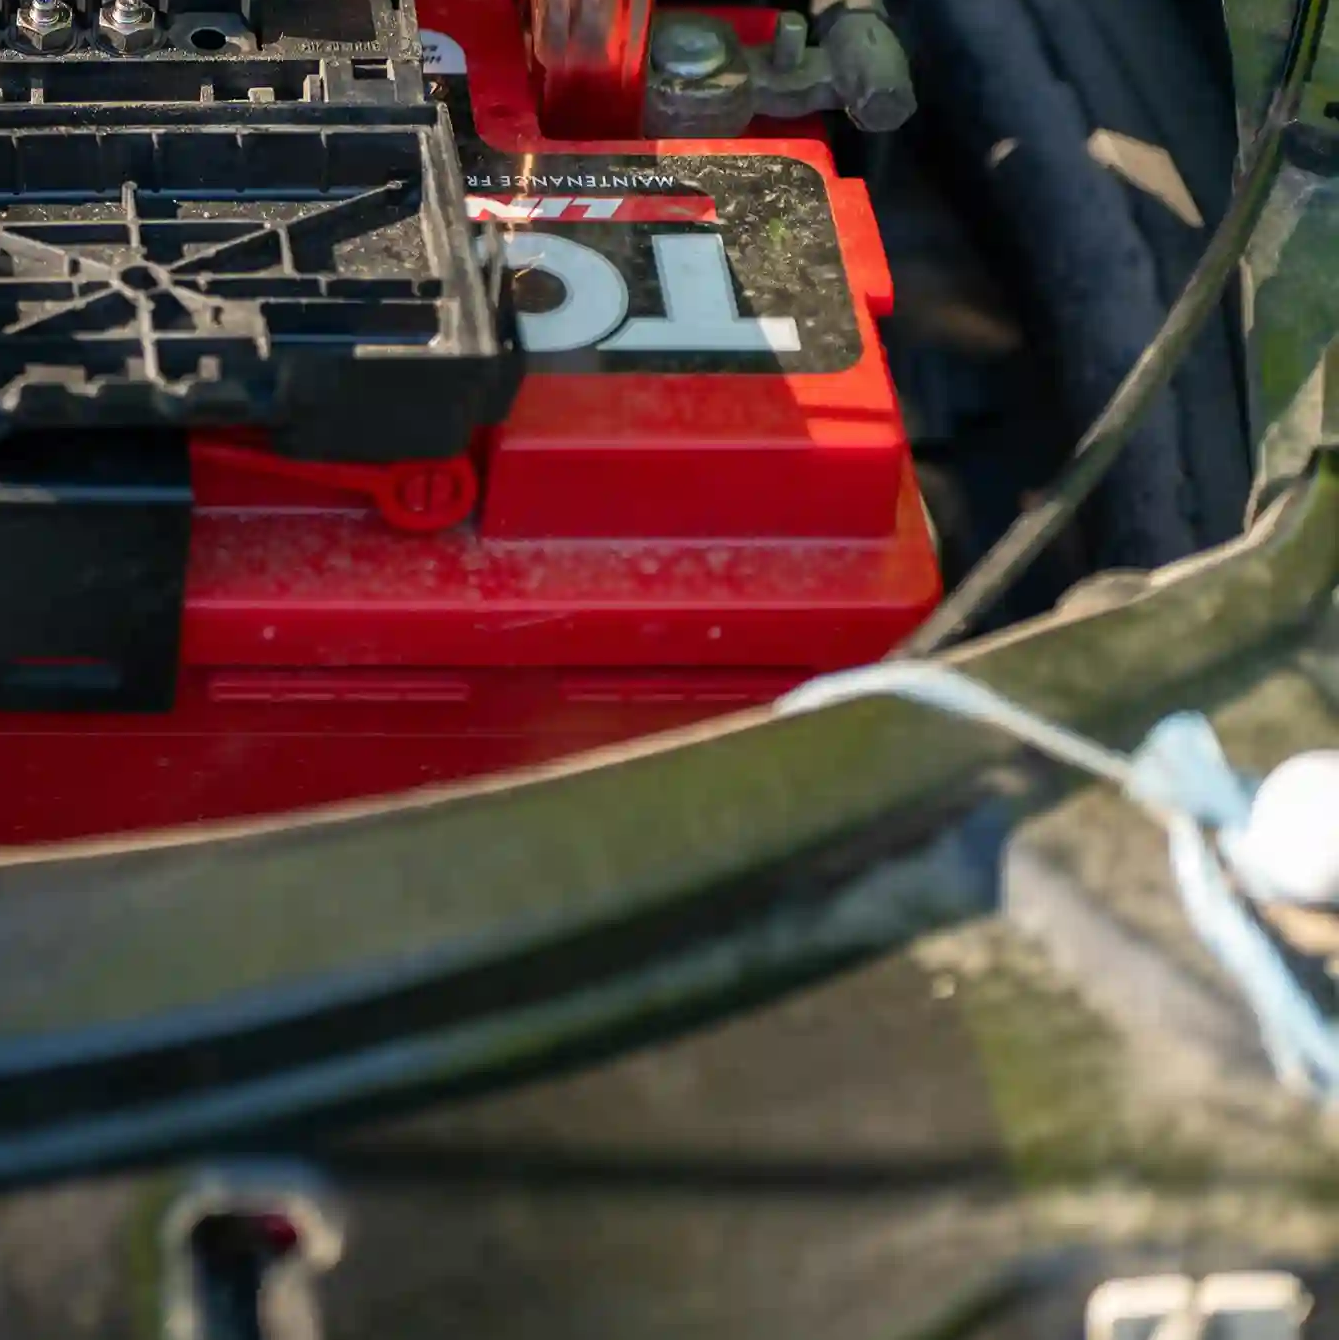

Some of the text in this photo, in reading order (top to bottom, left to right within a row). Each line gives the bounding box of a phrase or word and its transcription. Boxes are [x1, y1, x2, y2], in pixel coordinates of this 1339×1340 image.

[466, 175, 675, 189] MAINTENANCE FR
[464, 196, 624, 219] LIN
